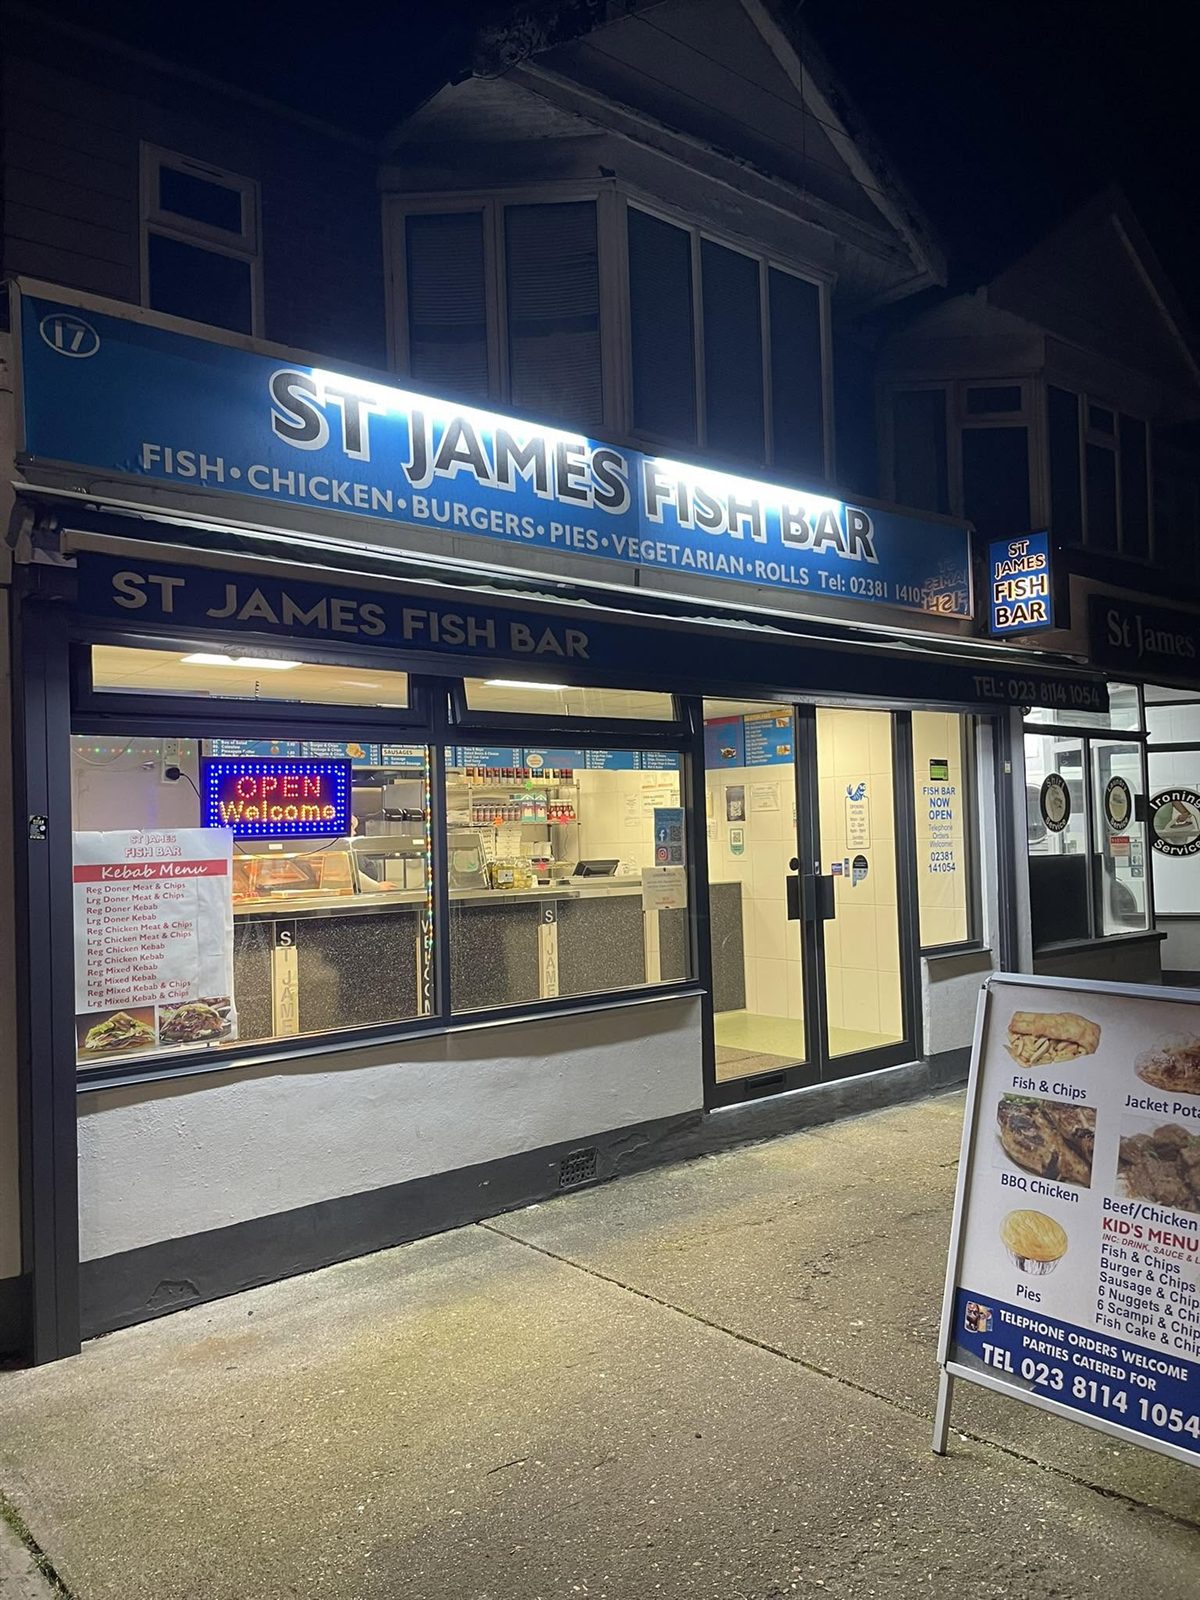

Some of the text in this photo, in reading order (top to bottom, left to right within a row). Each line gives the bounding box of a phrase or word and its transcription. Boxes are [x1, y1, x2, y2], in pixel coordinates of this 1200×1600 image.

[55, 320, 85, 351] 17
[268, 369, 878, 564] ST JAMES FISH BAR
[142, 442, 224, 482] FISH
[247, 463, 393, 511] CHICKEN
[411, 499, 536, 540] BURGERS
[550, 524, 599, 551] PIES
[612, 534, 744, 575] VEGETARIAN
[755, 559, 810, 586] ROLLS
[818, 571, 845, 591] Tel:
[850, 577, 887, 598] 02381
[1008, 540, 1029, 557] ST
[995, 554, 1045, 579] JAMES
[994, 573, 1048, 604] FISH
[112, 571, 590, 660] ST JAMES FISH BAR
[995, 601, 1047, 628] BAR
[1107, 609, 1195, 658] St James
[973, 676, 1100, 704] TEL: 023 8114 1054
[237, 776, 321, 798] OPEN
[923, 787, 956, 795] FISH BAR
[218, 800, 337, 823] Welcome
[930, 798, 949, 807] NOW
[1150, 792, 1200, 810] Ironing
[929, 810, 952, 820] OPEN
[1046, 818, 1067, 829] Service
[130, 834, 176, 844] ST JAMES
[1154, 840, 1200, 855] Service
[125, 846, 181, 858] FISH BAR
[931, 852, 953, 861] 02381
[101, 864, 207, 879] Kebab Menu
[929, 863, 956, 872] 141054
[86, 897, 101, 905] Lrg
[87, 907, 102, 915] Reg
[87, 918, 101, 926] Lrg
[171, 921, 192, 929] Chips
[170, 931, 191, 939] Chips
[88, 959, 102, 967] Lrg
[105, 977, 129, 985] Mixed
[132, 974, 157, 982] Kebab
[106, 986, 131, 994] Mixed
[133, 984, 158, 992] Kebab
[105, 997, 130, 1005] Mixed
[1012, 1076, 1087, 1100] Fish & Chips
[1125, 1095, 1200, 1118] Jacket Pota
[1001, 1173, 1079, 1202] BBQ Chicken
[1103, 1197, 1198, 1231] Beef/Chicken
[1102, 1217, 1199, 1252] KID'S MENU
[1102, 1243, 1127, 1260] Fish
[1131, 1252, 1139, 1263] &
[1144, 1255, 1180, 1274] Chips
[1153, 1245, 1183, 1260] SAUCE
[1186, 1254, 1193, 1262] &
[1099, 1271, 1152, 1295] Sausage
[1156, 1288, 1165, 1299] &
[1101, 1258, 1196, 1293] Burger & Chips
[1016, 1284, 1041, 1303] Pies
[1098, 1285, 1105, 1296] 6
[1109, 1288, 1160, 1312] Nuggets
[1164, 1304, 1173, 1316] &
[1097, 1299, 1104, 1310] 6
[1108, 1302, 1153, 1325] Scampi
[1157, 1317, 1166, 1329] &
[1096, 1313, 1121, 1330] Fish
[1125, 1321, 1156, 1341] Cake
[1161, 1332, 1169, 1344] &
[1000, 1309, 1189, 1381] TELEPHONE ORDERS WELCOME
[1023, 1335, 1156, 1391] PARTIES CATERED FOR
[982, 1343, 1200, 1439] TEL 023 8114 1054
